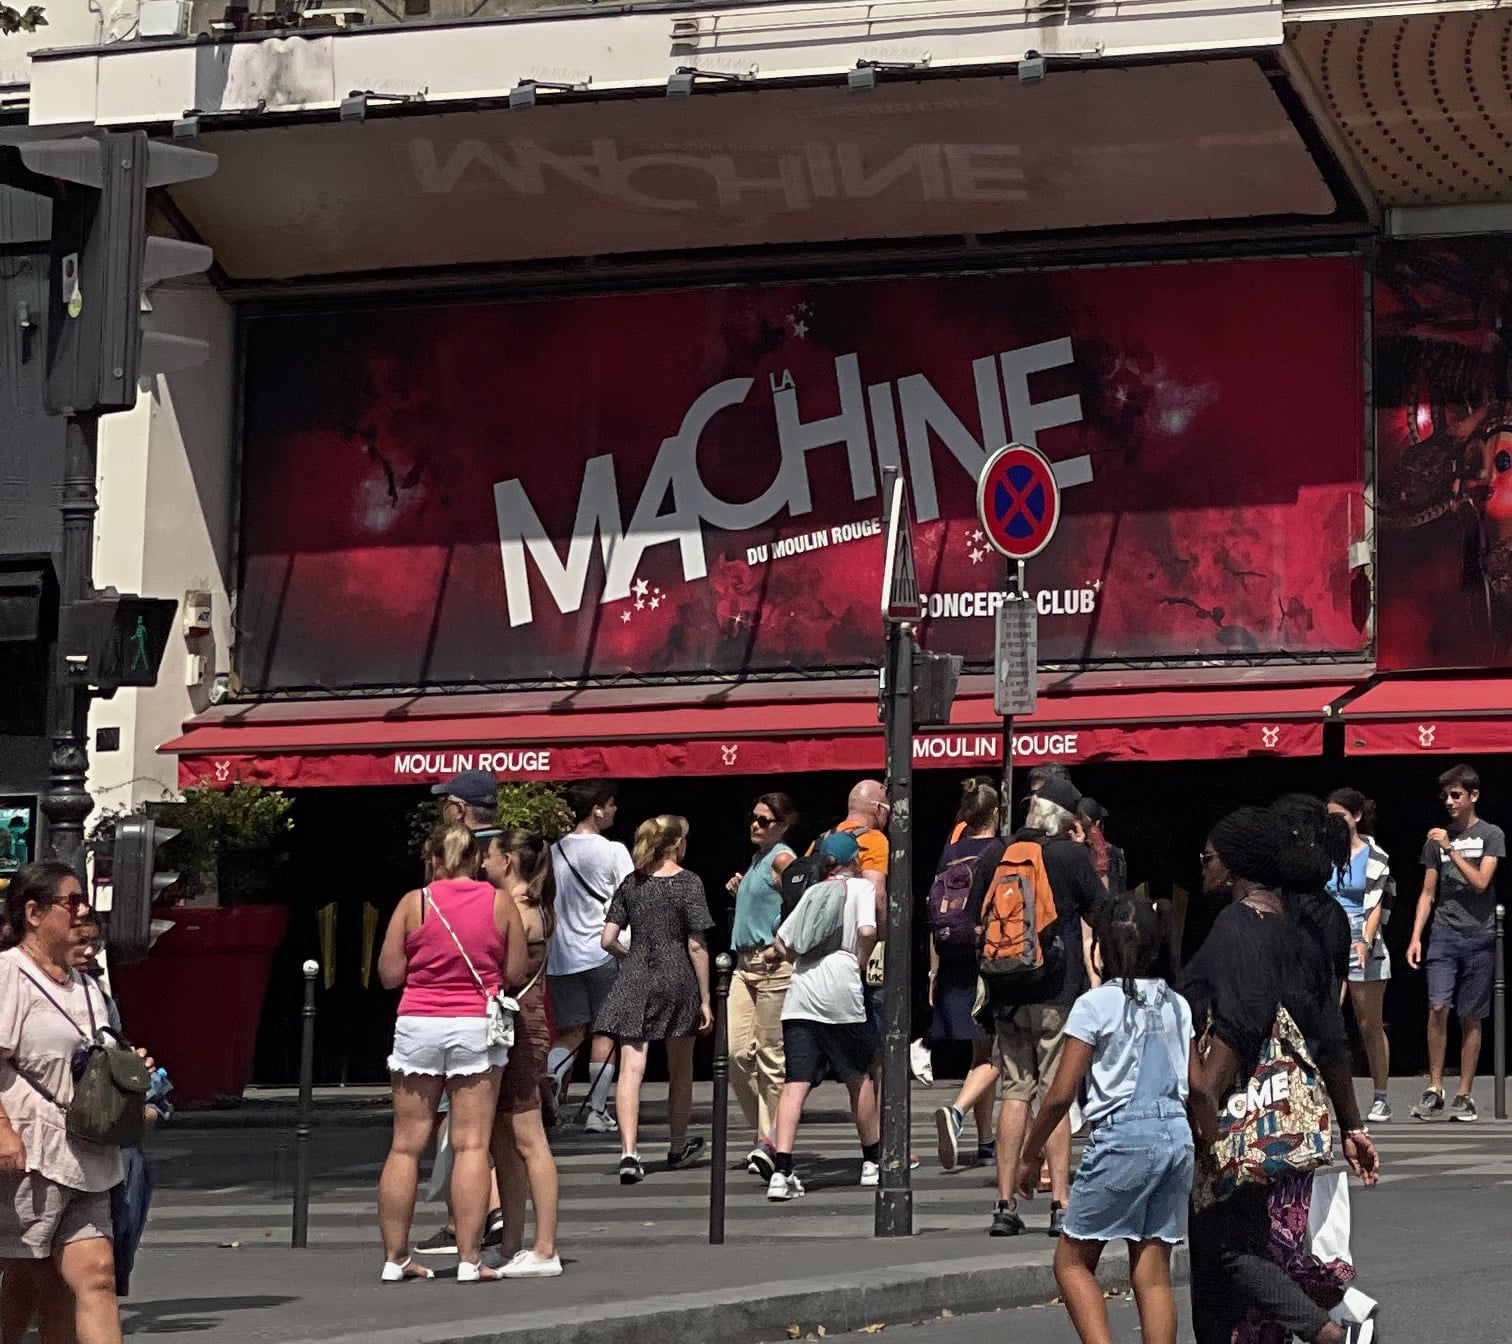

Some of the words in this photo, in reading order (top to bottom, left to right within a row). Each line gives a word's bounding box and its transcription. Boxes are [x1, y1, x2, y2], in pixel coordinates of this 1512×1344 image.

[769, 368, 796, 392] LA
[493, 336, 1094, 627] MACHINE
[746, 534, 769, 566] DU
[771, 529, 829, 560] MOULIN
[831, 517, 882, 544] ROUGE
[1036, 588, 1095, 615] CLUB
[912, 737, 997, 758] MOULIN
[394, 753, 473, 774] MOULIN
[478, 751, 551, 772] ROUGE
[1221, 1070, 1290, 1119] OME
